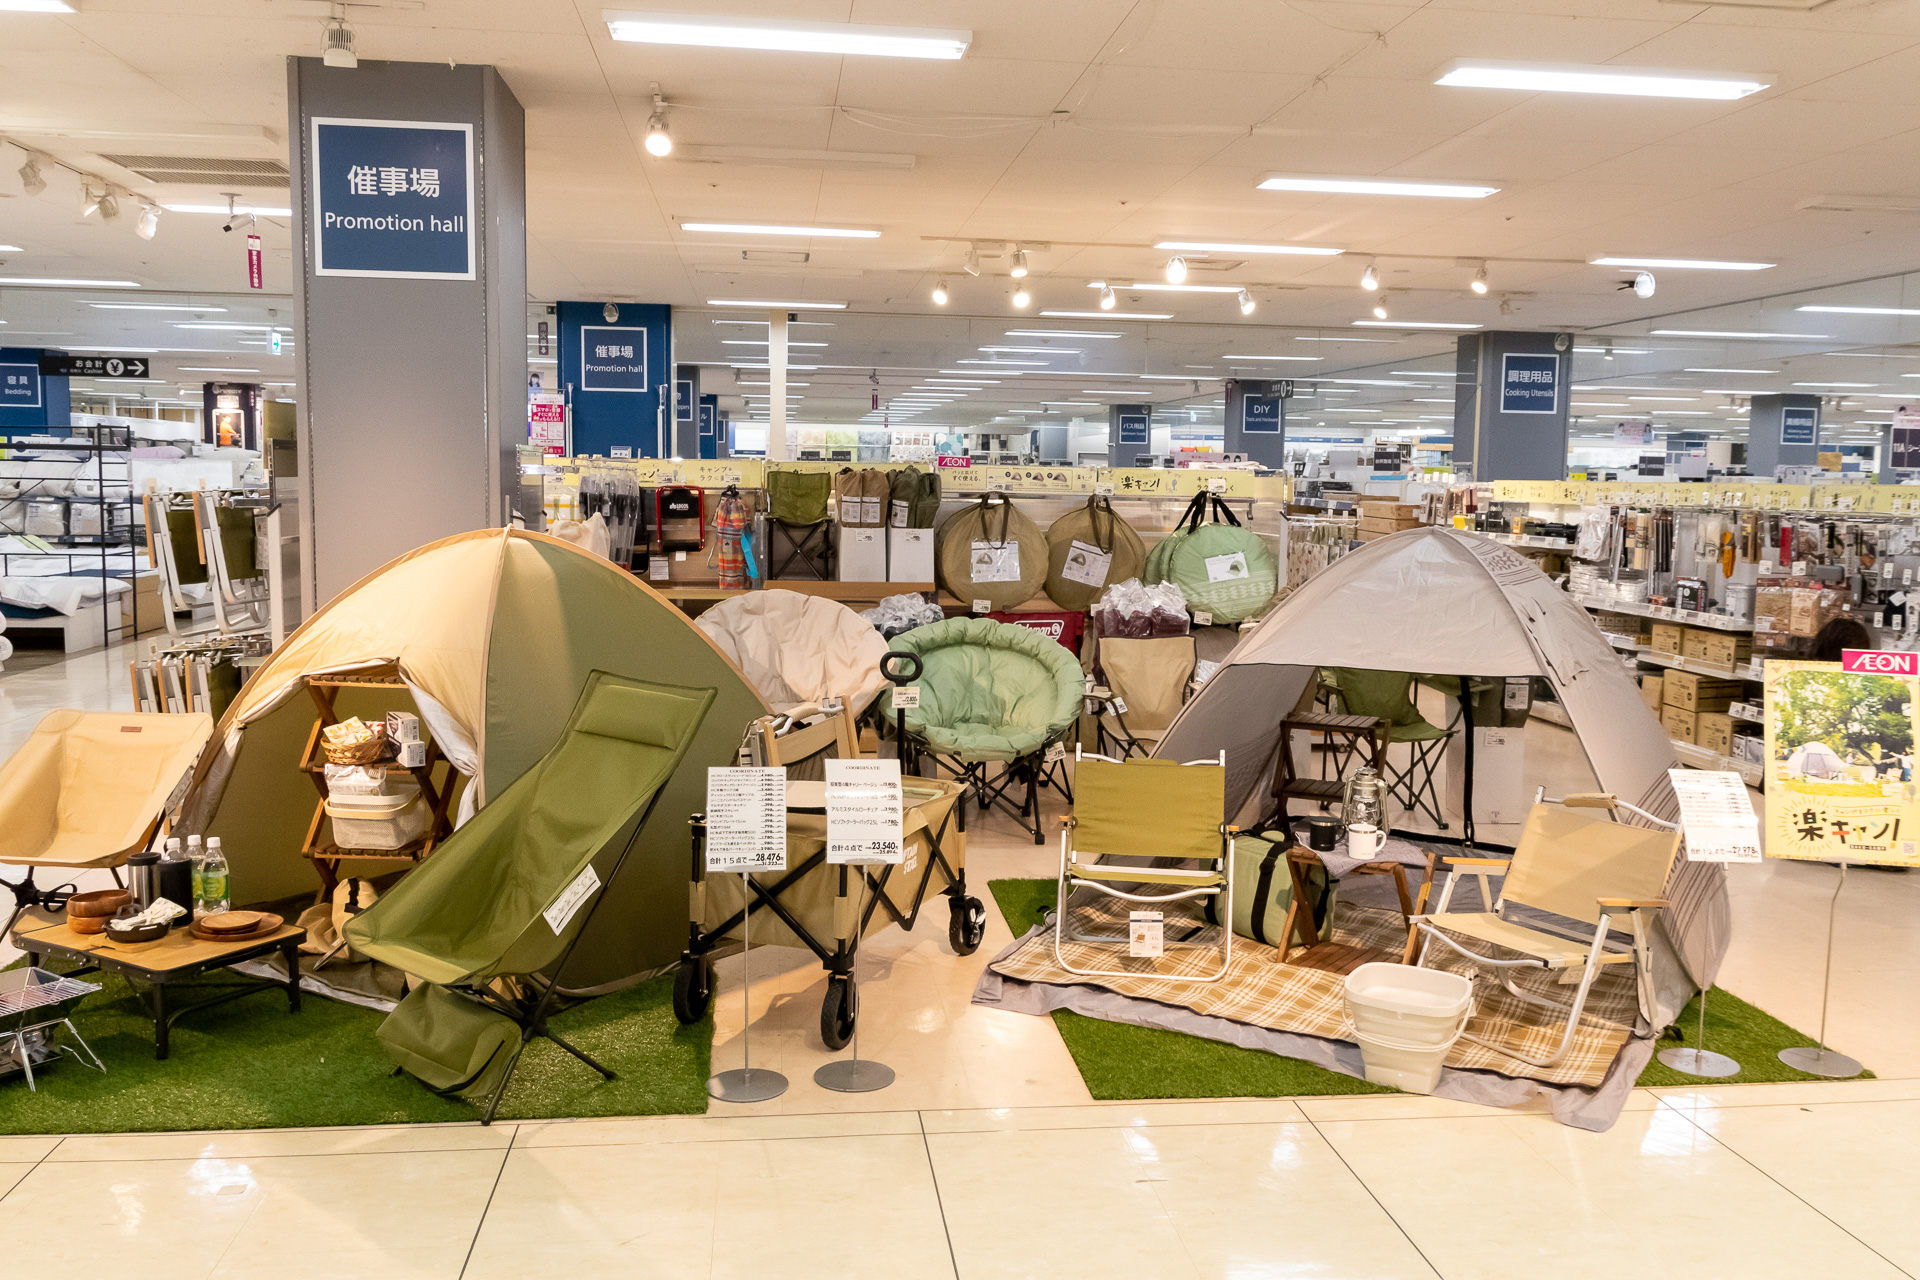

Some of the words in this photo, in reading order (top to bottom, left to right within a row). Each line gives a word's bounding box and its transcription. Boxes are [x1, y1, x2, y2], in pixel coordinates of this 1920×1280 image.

[347, 165, 440, 198] 催事場
[325, 212, 424, 231] Promotion
[430, 215, 464, 233] hall
[595, 345, 633, 358] 催事場
[75, 360, 103, 368] お会計
[585, 364, 625, 373] Promotion
[628, 365, 643, 373] hall
[7, 376, 28, 385] 寝具
[1508, 370, 1552, 383] 調理用品
[5, 388, 31, 396] Bedding
[1505, 389, 1529, 398] Cooking
[1531, 389, 1554, 397] Utensils
[1254, 405, 1270, 413] DIY
